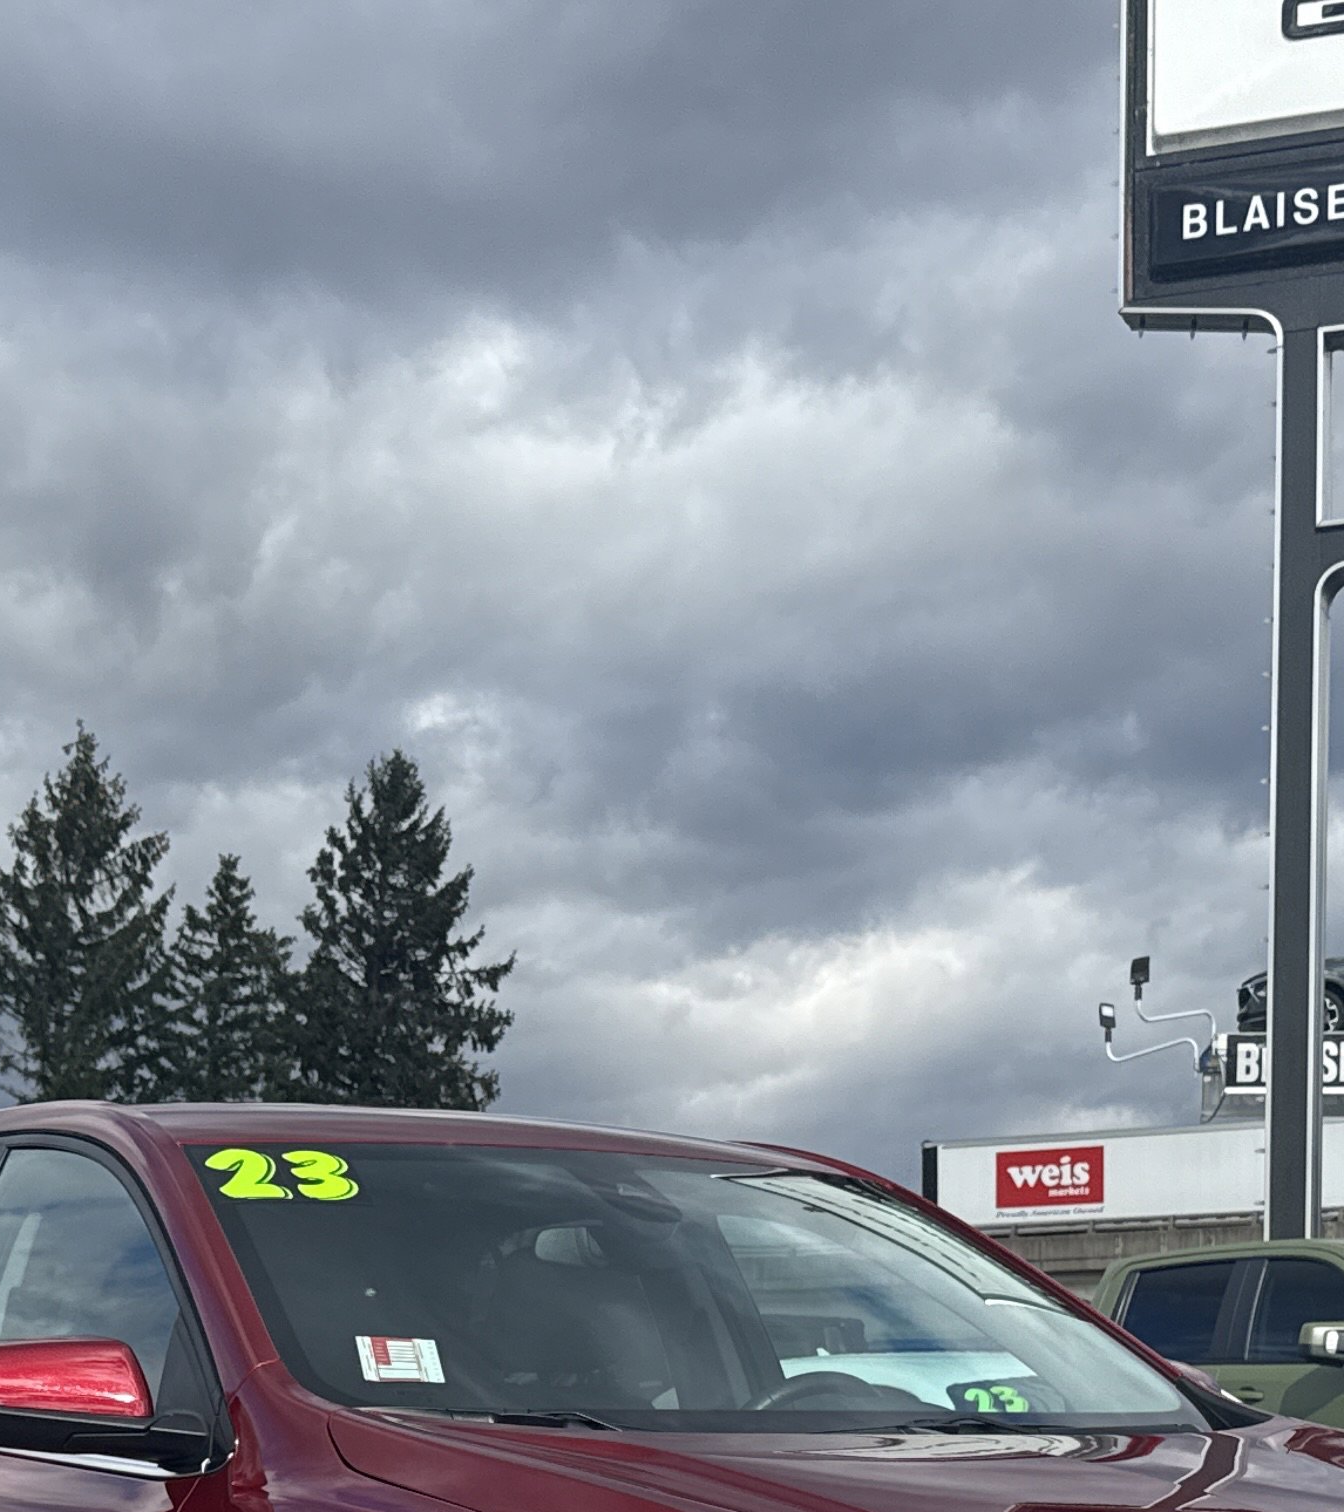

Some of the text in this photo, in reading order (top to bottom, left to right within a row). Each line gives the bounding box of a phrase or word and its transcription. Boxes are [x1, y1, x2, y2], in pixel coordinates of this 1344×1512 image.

[204, 1148, 359, 1201] 23
[1006, 1155, 1091, 1189] weis
[963, 1385, 1029, 1413] 23
